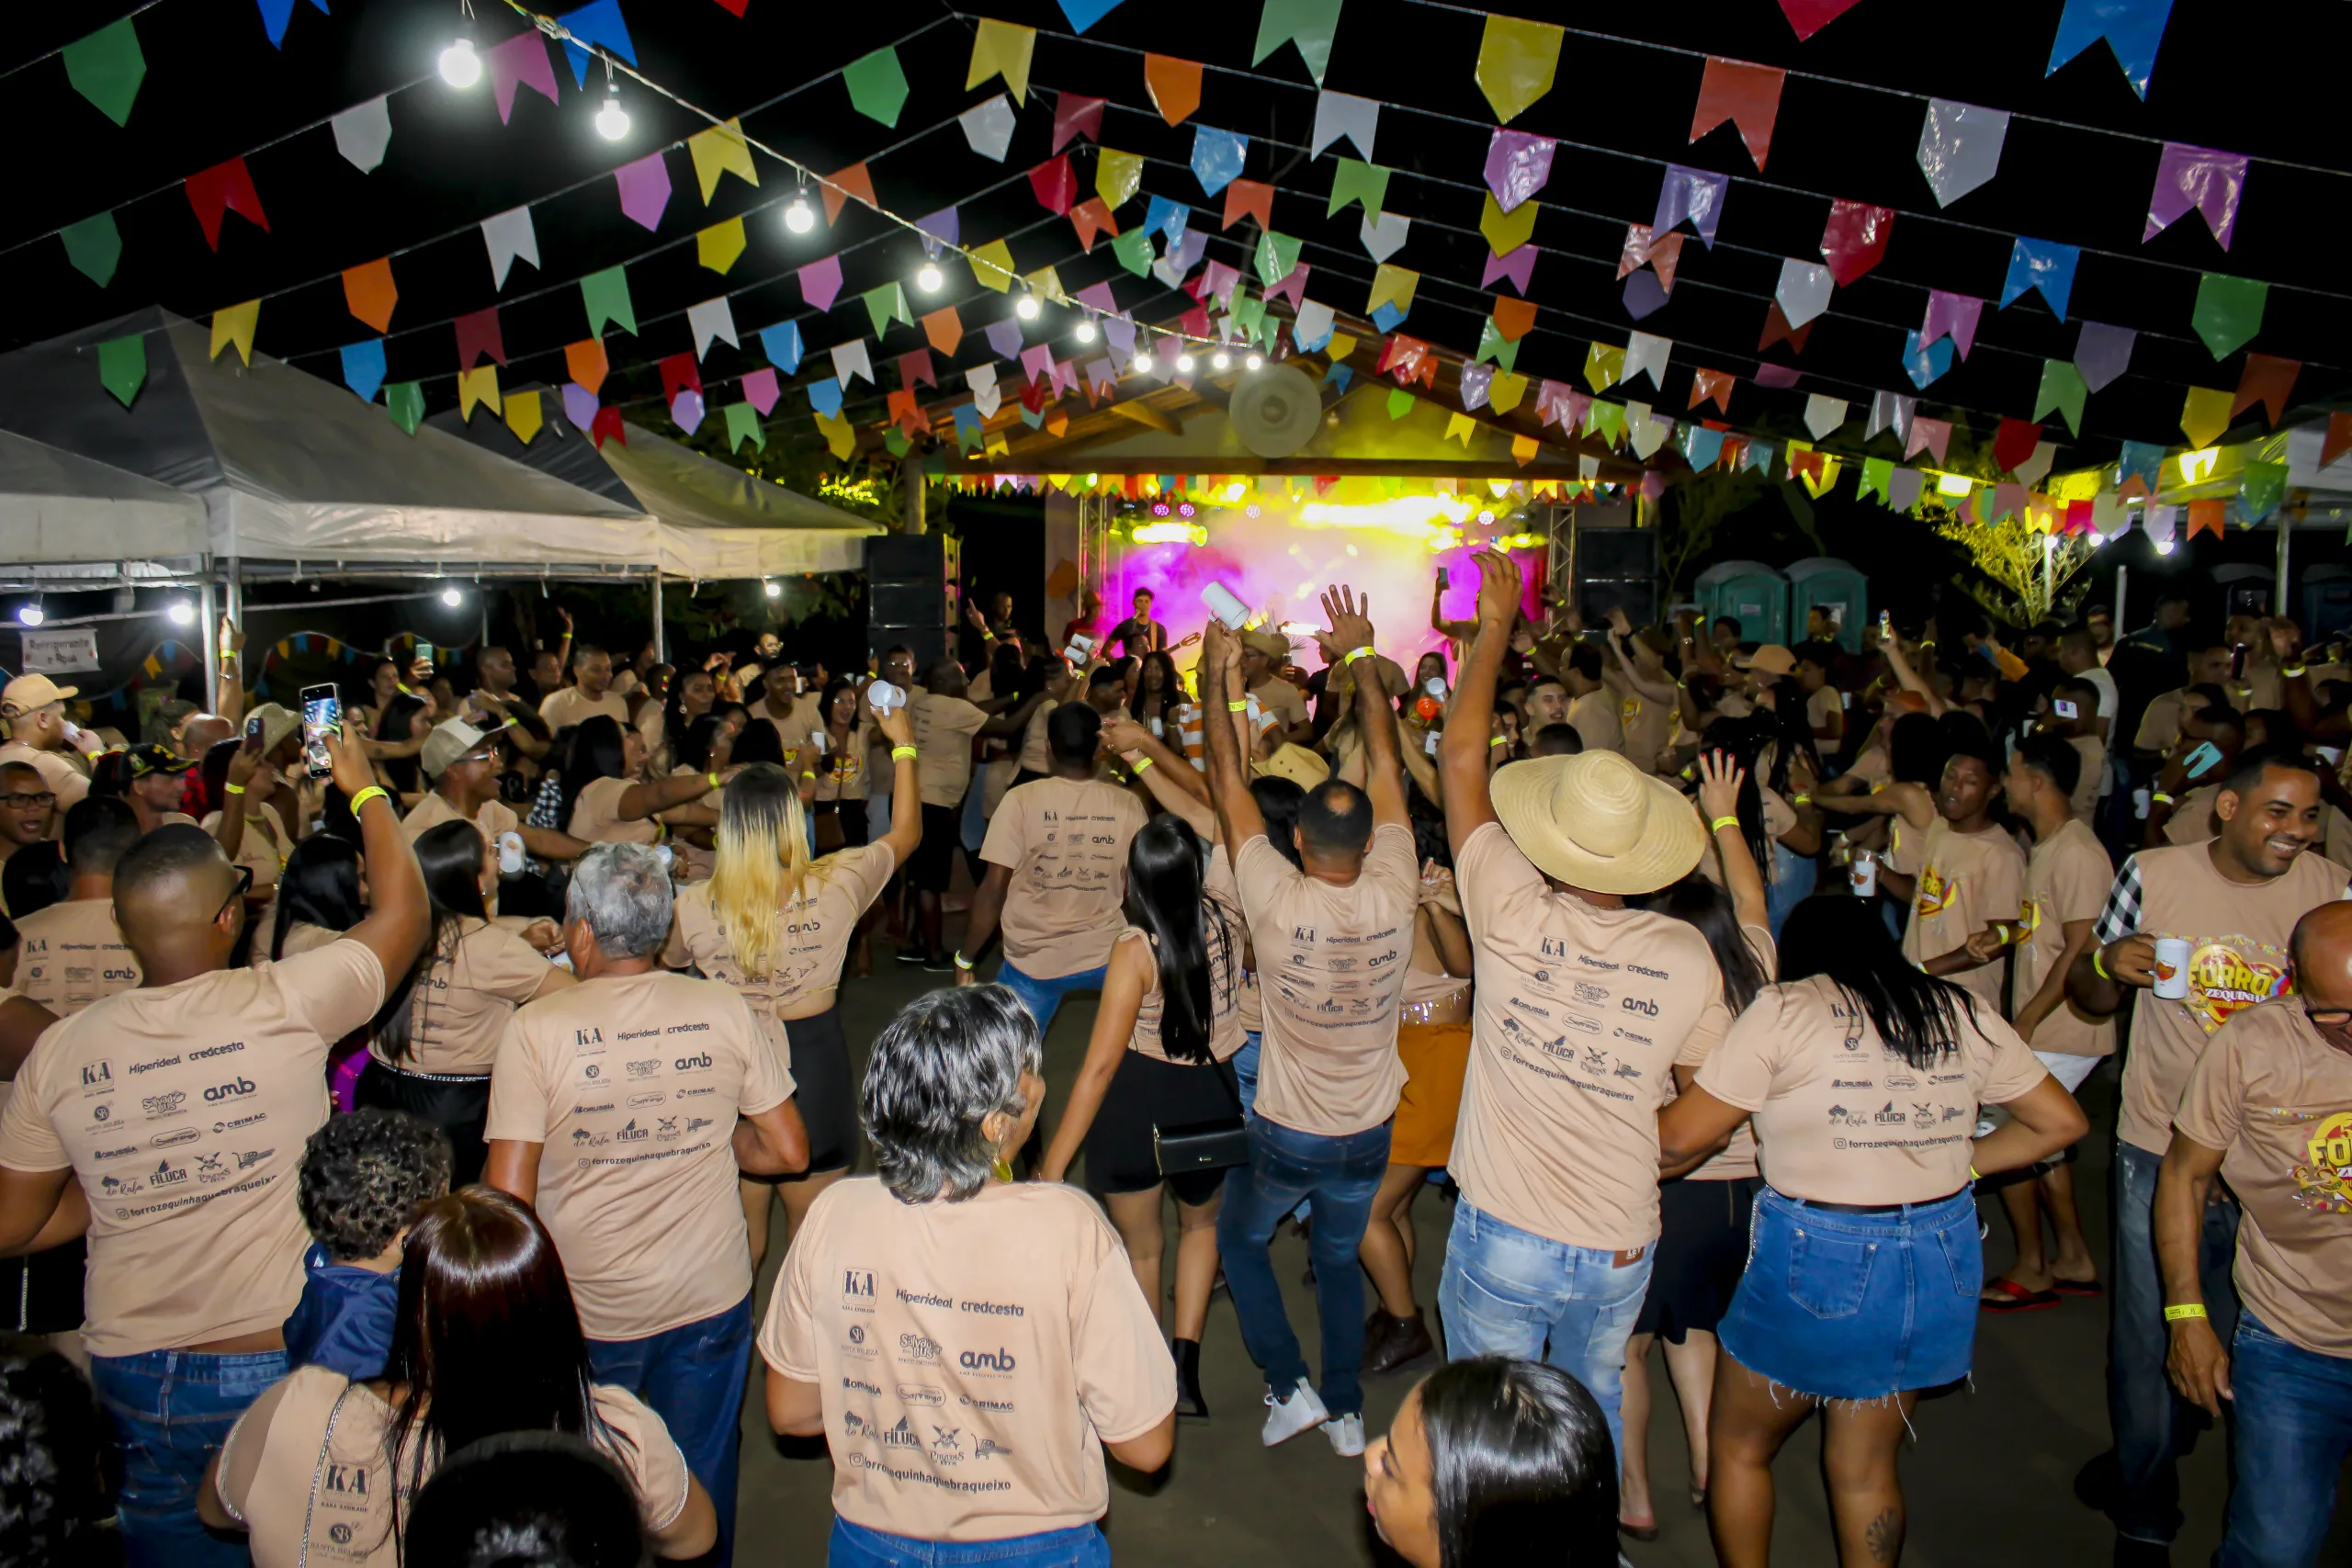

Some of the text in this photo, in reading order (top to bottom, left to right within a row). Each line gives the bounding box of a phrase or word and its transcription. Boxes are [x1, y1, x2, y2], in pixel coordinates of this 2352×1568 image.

[1045, 811, 1057, 821] KA
[1092, 835, 1114, 844] amb
[1295, 927, 1314, 942] KA
[27, 939, 48, 953] KA
[1542, 936, 1565, 957] KA
[1369, 949, 1396, 966] amb
[103, 966, 136, 979] amb
[1577, 954, 1668, 980] Hiperideal credcesta
[1623, 997, 1658, 1017] amb
[576, 1027, 604, 1045] KA
[617, 1022, 709, 1041] Hiperideal credcesta
[129, 1042, 244, 1075] Hiperideal credcesta
[674, 1052, 712, 1071] amb
[83, 1062, 112, 1085] KA
[1939, 1073, 1965, 1081] CRIMAC
[203, 1077, 255, 1101] amb
[687, 1087, 716, 1096] CRIMAC
[227, 1112, 267, 1128] CRIMAC
[1849, 1134, 1963, 1148] forrozequinhaquebraqueixo
[592, 1142, 711, 1166] forrozequinhaquebraqueixo
[845, 1270, 875, 1297] KA
[896, 1289, 1024, 1317] Hiperideal credcesta
[912, 1346, 933, 1359] BUS
[959, 1347, 1015, 1372] amb
[972, 1399, 1014, 1410] CRIMAC
[326, 1465, 367, 1494] KA
